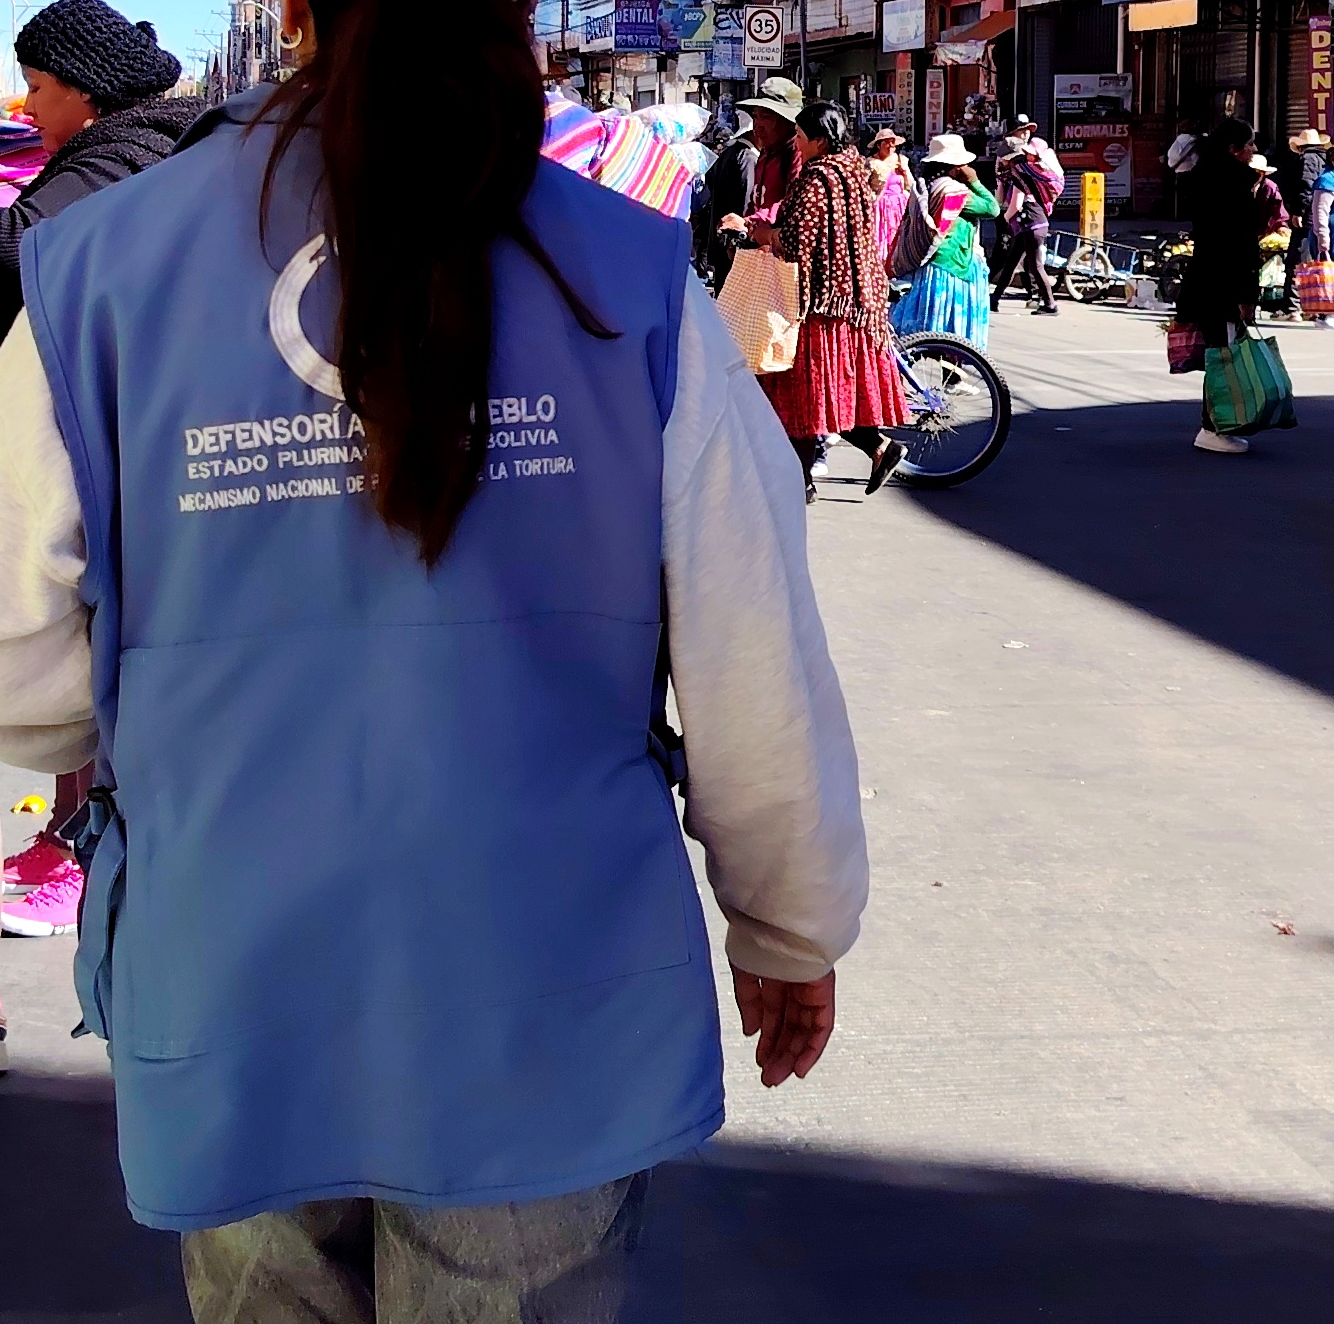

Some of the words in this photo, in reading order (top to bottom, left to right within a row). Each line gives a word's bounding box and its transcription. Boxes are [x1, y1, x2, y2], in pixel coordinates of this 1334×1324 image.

[616, 8, 655, 23] DENTAL
[753, 18, 775, 35] 35
[746, 46, 781, 55] VELOCIDAD
[1064, 124, 1129, 139] NORMALES
[185, 403, 367, 456] DEFENSORÍA
[187, 452, 270, 480] ESTADO
[178, 488, 261, 513] MECANISMO
[266, 479, 341, 502] NACIONAL
[346, 477, 365, 494] DE
[489, 462, 509, 481] LA
[514, 455, 576, 477] TORTURA
